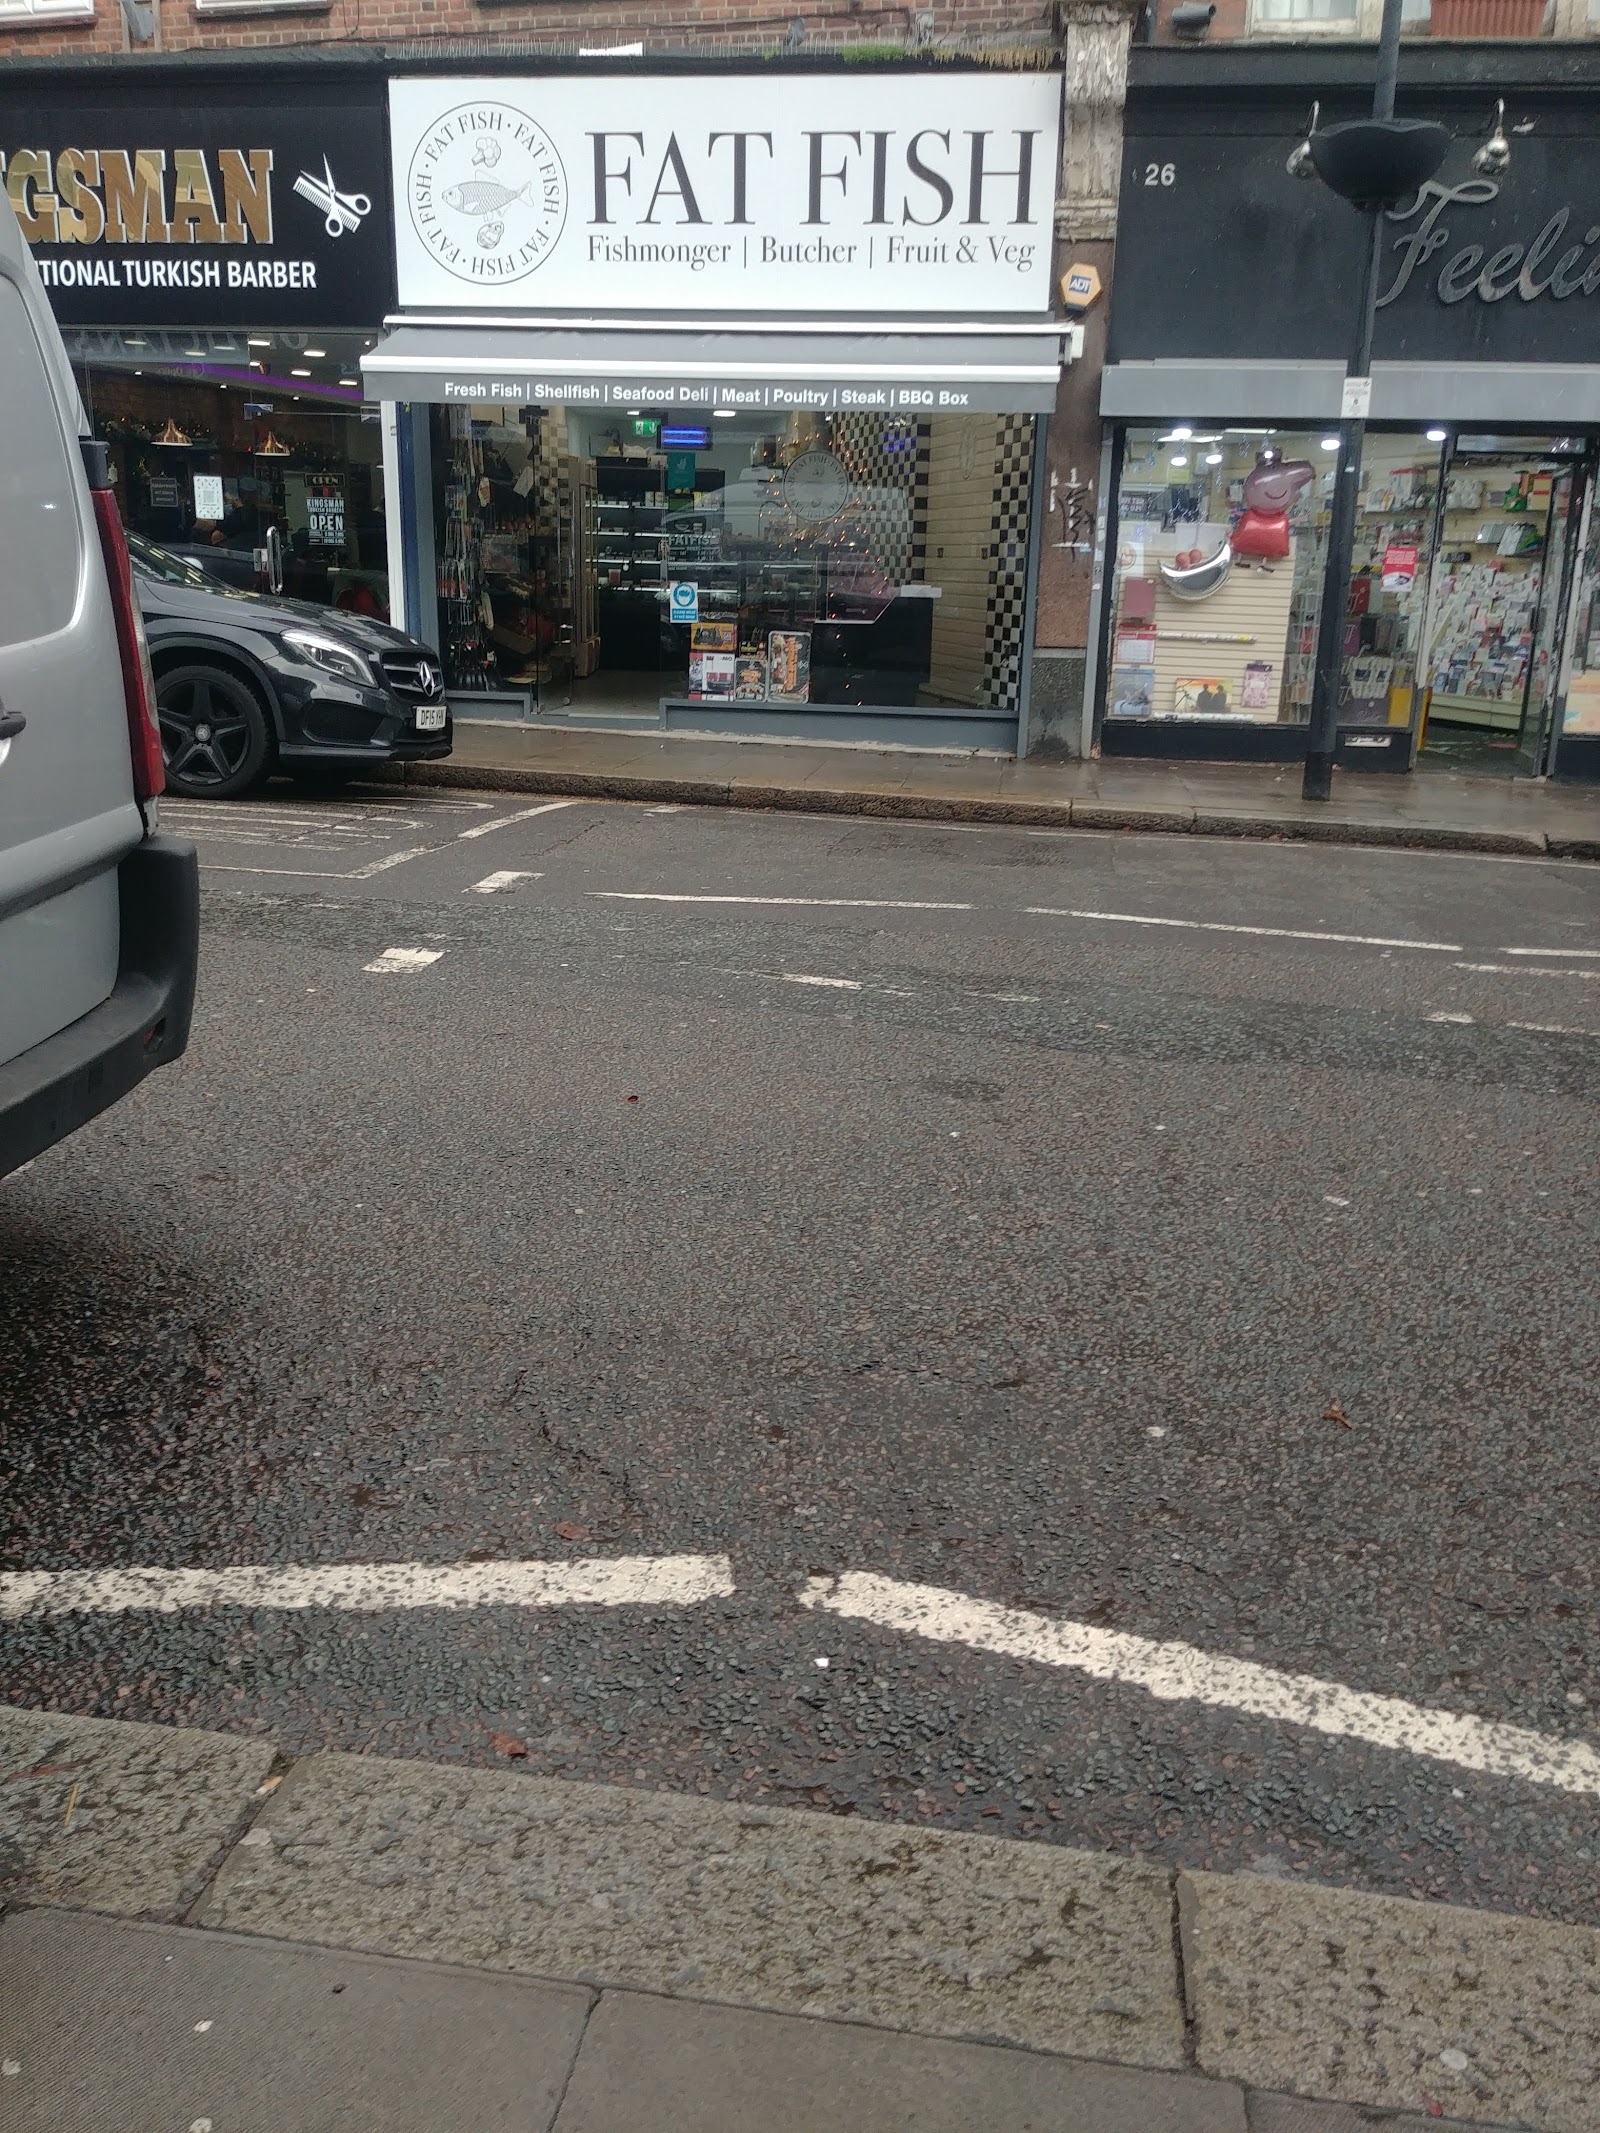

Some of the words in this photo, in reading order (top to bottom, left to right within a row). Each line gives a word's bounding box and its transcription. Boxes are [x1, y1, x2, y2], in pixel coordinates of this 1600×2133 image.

[457, 111, 502, 134] FISH
[513, 122, 548, 159] FAT
[424, 123, 455, 163] FAT
[539, 162, 560, 215] FISH
[585, 130, 773, 225] FAT
[799, 129, 1043, 226] FISH
[1144, 162, 1176, 187] 26
[0, 148, 274, 244] GSMAN
[415, 173, 436, 224] FISH
[426, 228, 461, 264] FAT
[517, 228, 550, 267] FAT
[587, 234, 731, 272] Fishmonger
[760, 234, 857, 264] Butcher
[886, 234, 949, 264] Fruit
[955, 235, 980, 264] &
[986, 235, 1036, 273] Veg
[122, 260, 221, 288] TURKISH
[228, 260, 318, 289] BARBER
[471, 255, 515, 276] FISH
[1069, 276, 1092, 292] ADT
[444, 382, 487, 398] Fresh
[491, 383, 522, 398] Fish
[534, 383, 600, 400] Shellfish
[612, 385, 675, 401] Seafood
[679, 387, 709, 401] Deli
[721, 388, 761, 403] Meat
[773, 388, 829, 407] Poultry
[841, 389, 886, 405] Steak
[899, 389, 934, 406] BBQ
[938, 391, 969, 406] Box
[306, 498, 345, 509] KINGSMAN
[309, 514, 344, 531] OPEN
